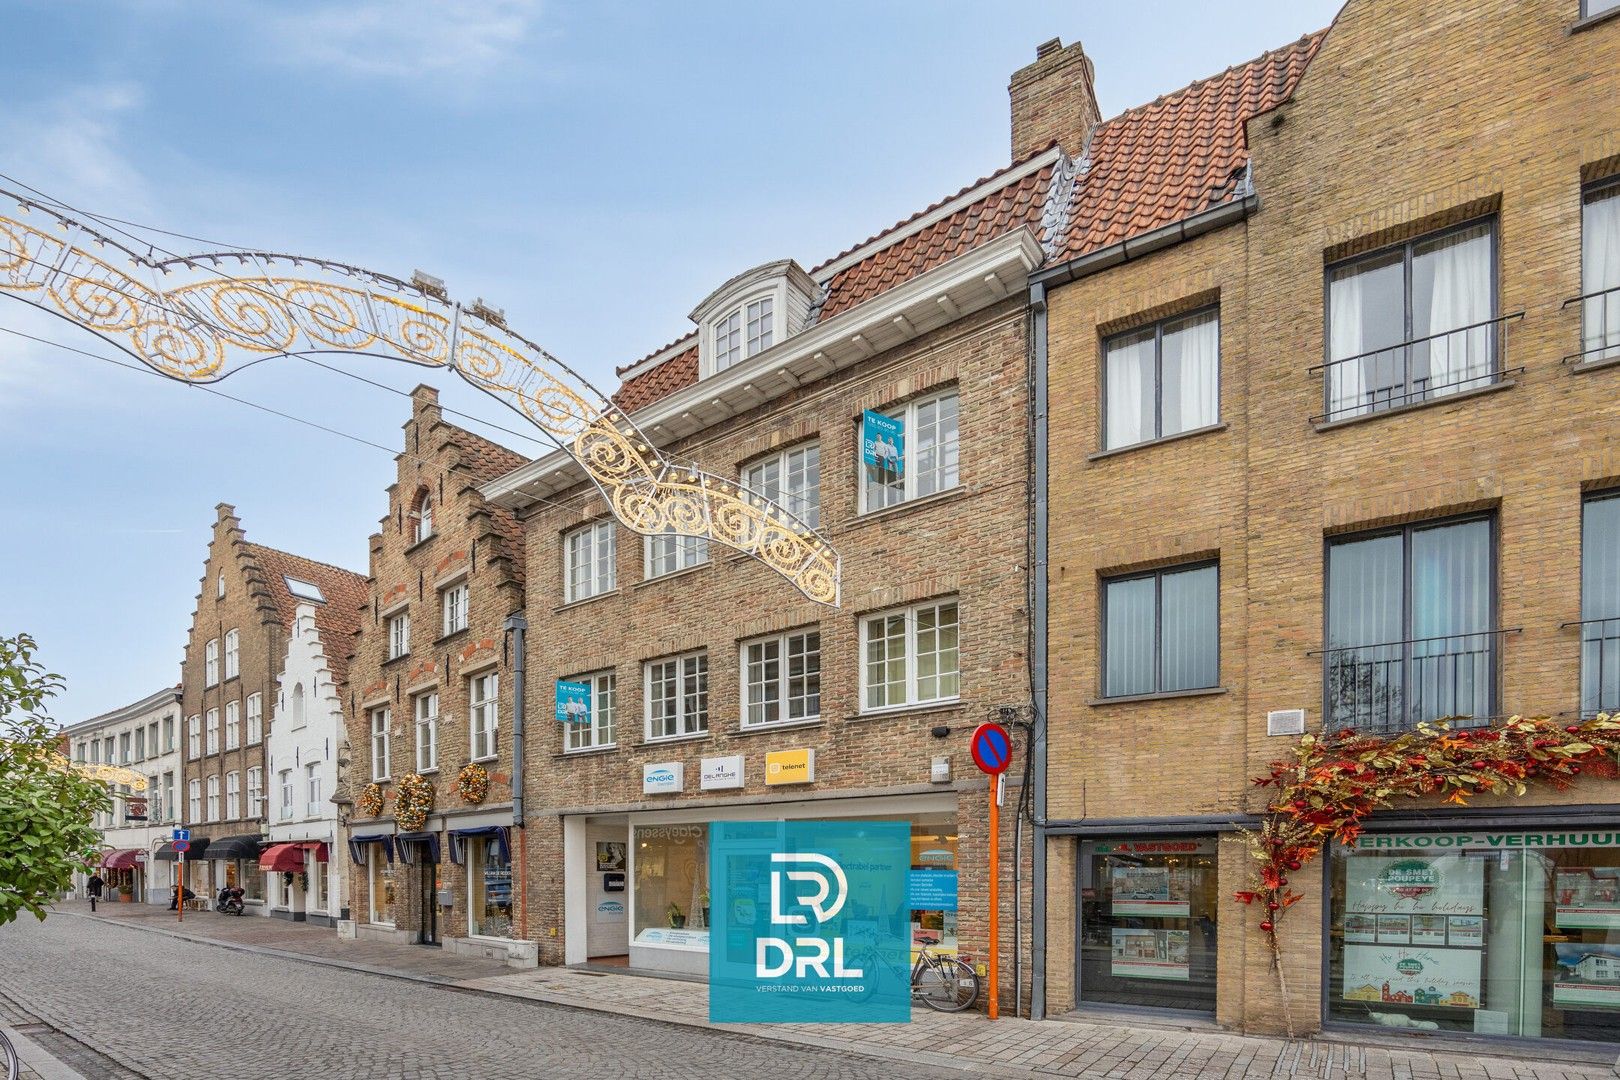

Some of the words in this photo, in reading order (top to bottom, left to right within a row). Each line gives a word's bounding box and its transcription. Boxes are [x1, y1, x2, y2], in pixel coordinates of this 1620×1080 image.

[877, 420, 896, 430] KOOP
[1352, 900, 1388, 912] Happy
[1431, 901, 1475, 913] holidays
